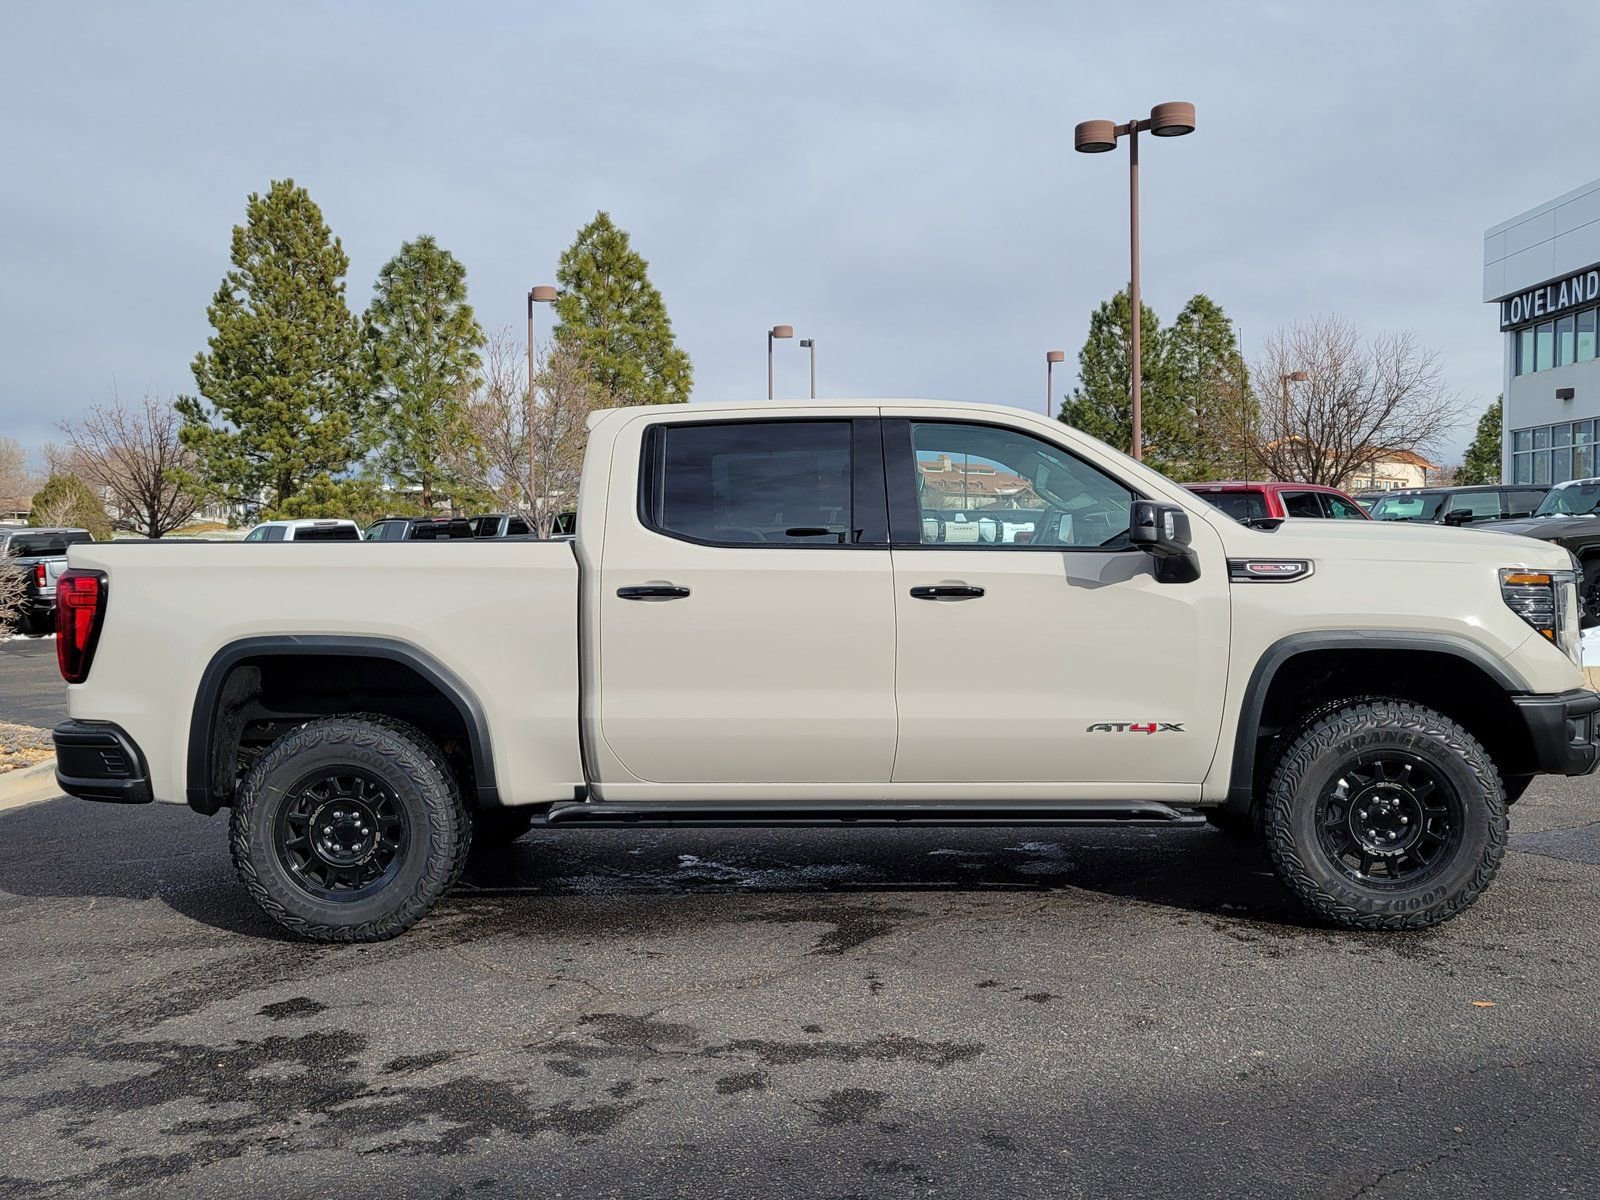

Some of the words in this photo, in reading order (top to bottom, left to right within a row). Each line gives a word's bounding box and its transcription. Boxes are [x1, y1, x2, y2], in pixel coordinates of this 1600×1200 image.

[1501, 270, 1599, 326] LOVELAND
[1085, 721, 1186, 735] AT4X
[1335, 730, 1452, 763] WRANGLER
[1376, 781, 1403, 790] GMC
[309, 804, 326, 825] GMC
[1323, 877, 1448, 913] GOODYEAR
